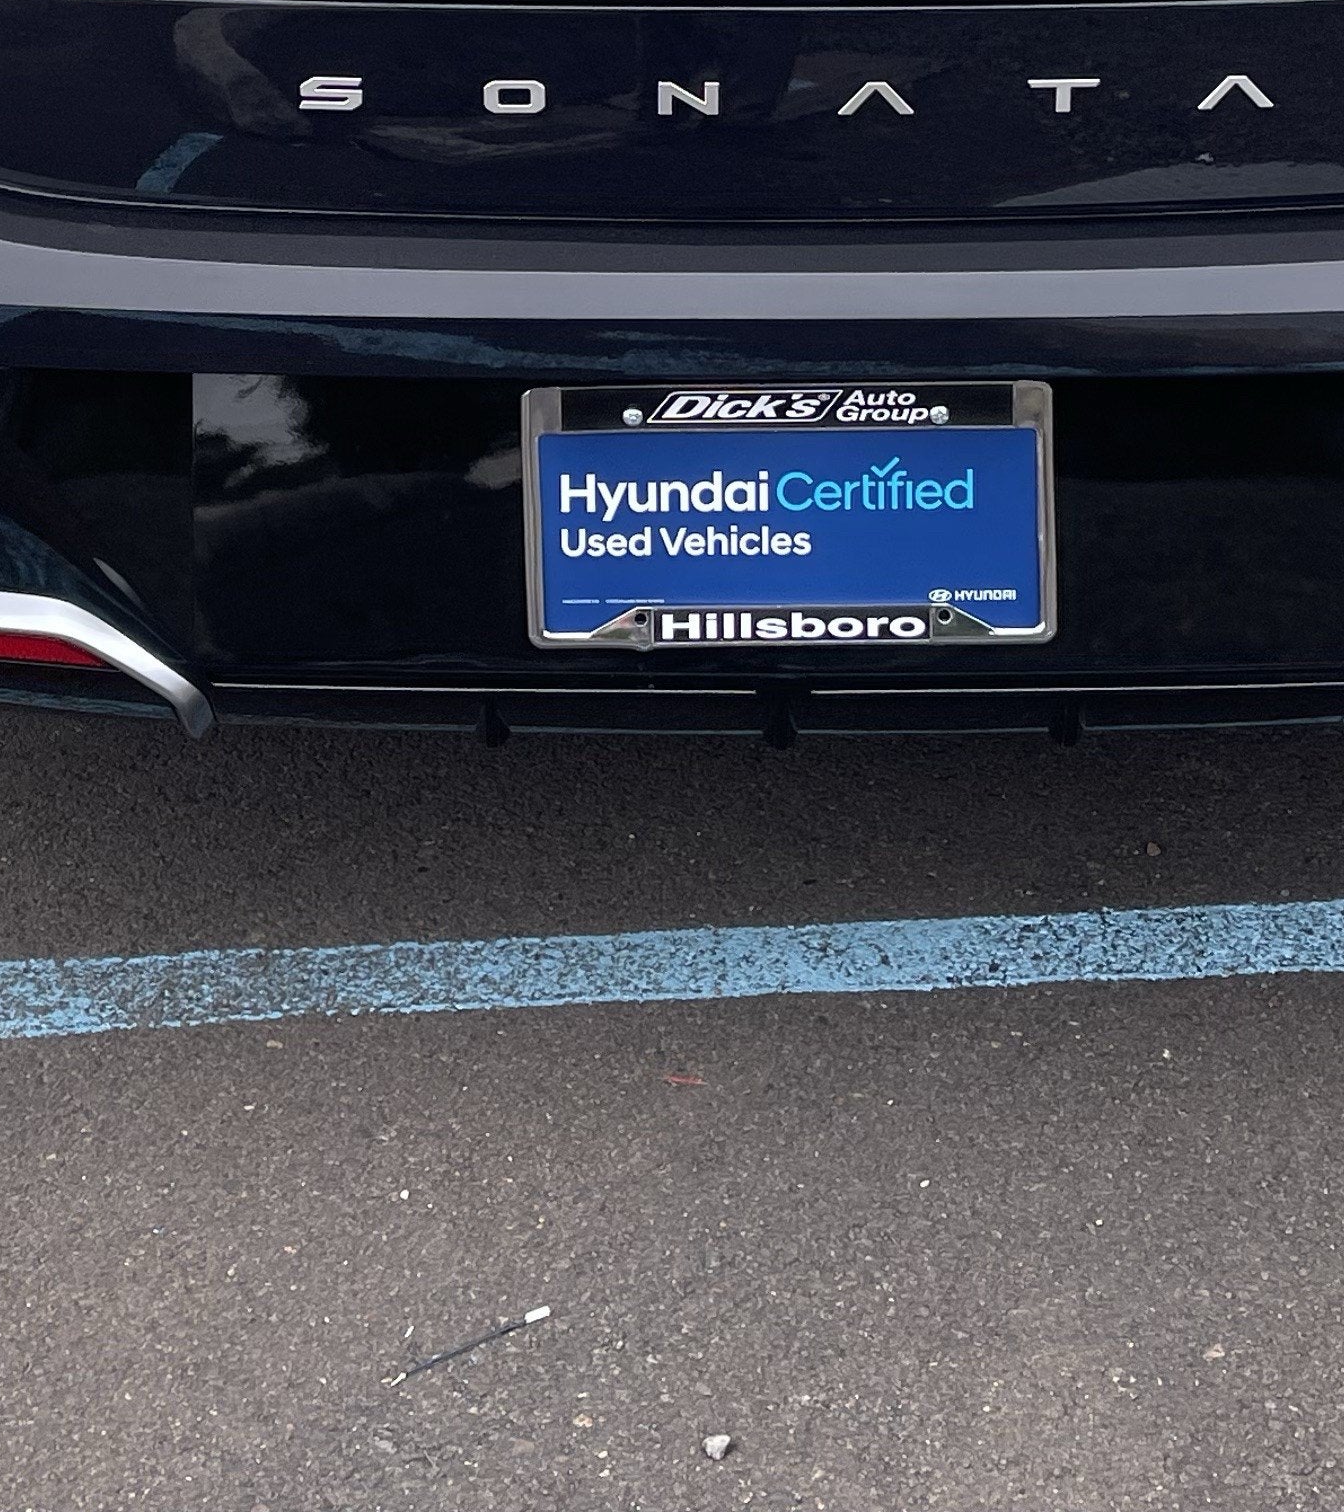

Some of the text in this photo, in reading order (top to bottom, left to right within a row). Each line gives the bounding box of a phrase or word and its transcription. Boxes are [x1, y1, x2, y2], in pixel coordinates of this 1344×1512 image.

[298, 74, 1275, 116] SONATA
[843, 390, 916, 406] Auto
[836, 404, 930, 425] Group
[559, 457, 975, 522] Hyundai Certified
[559, 524, 813, 558] Used Vehicles
[954, 589, 1017, 601] HYUNDAI
[660, 611, 927, 641] Hillsboro
